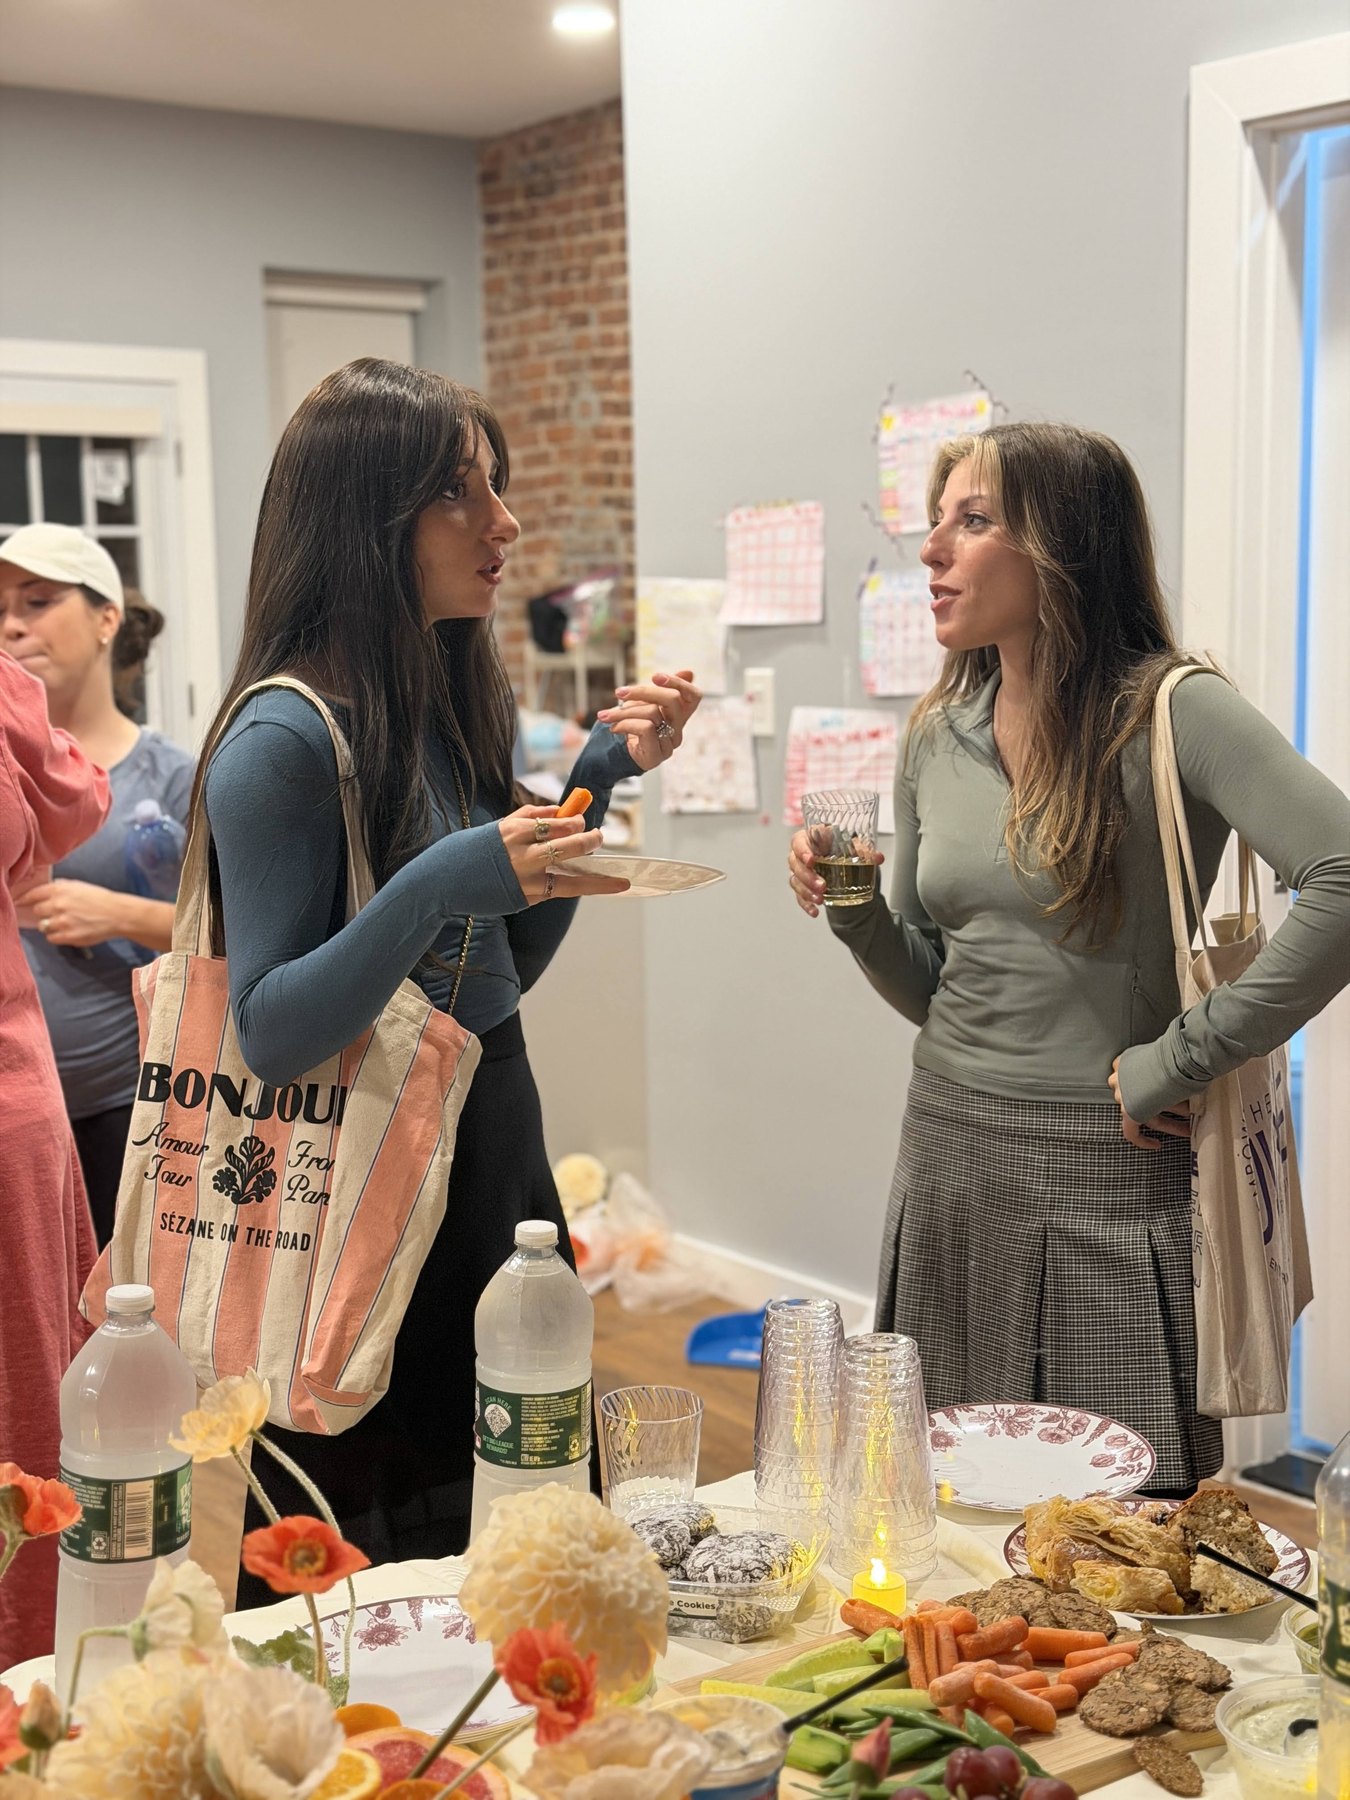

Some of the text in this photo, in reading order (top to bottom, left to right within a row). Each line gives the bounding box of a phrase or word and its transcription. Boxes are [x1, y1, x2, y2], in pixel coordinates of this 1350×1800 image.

[132, 1122, 209, 1157] Amour
[160, 1211, 311, 1251] SÉZANE ON THE ROAD
[677, 1600, 716, 1610] Cookies
